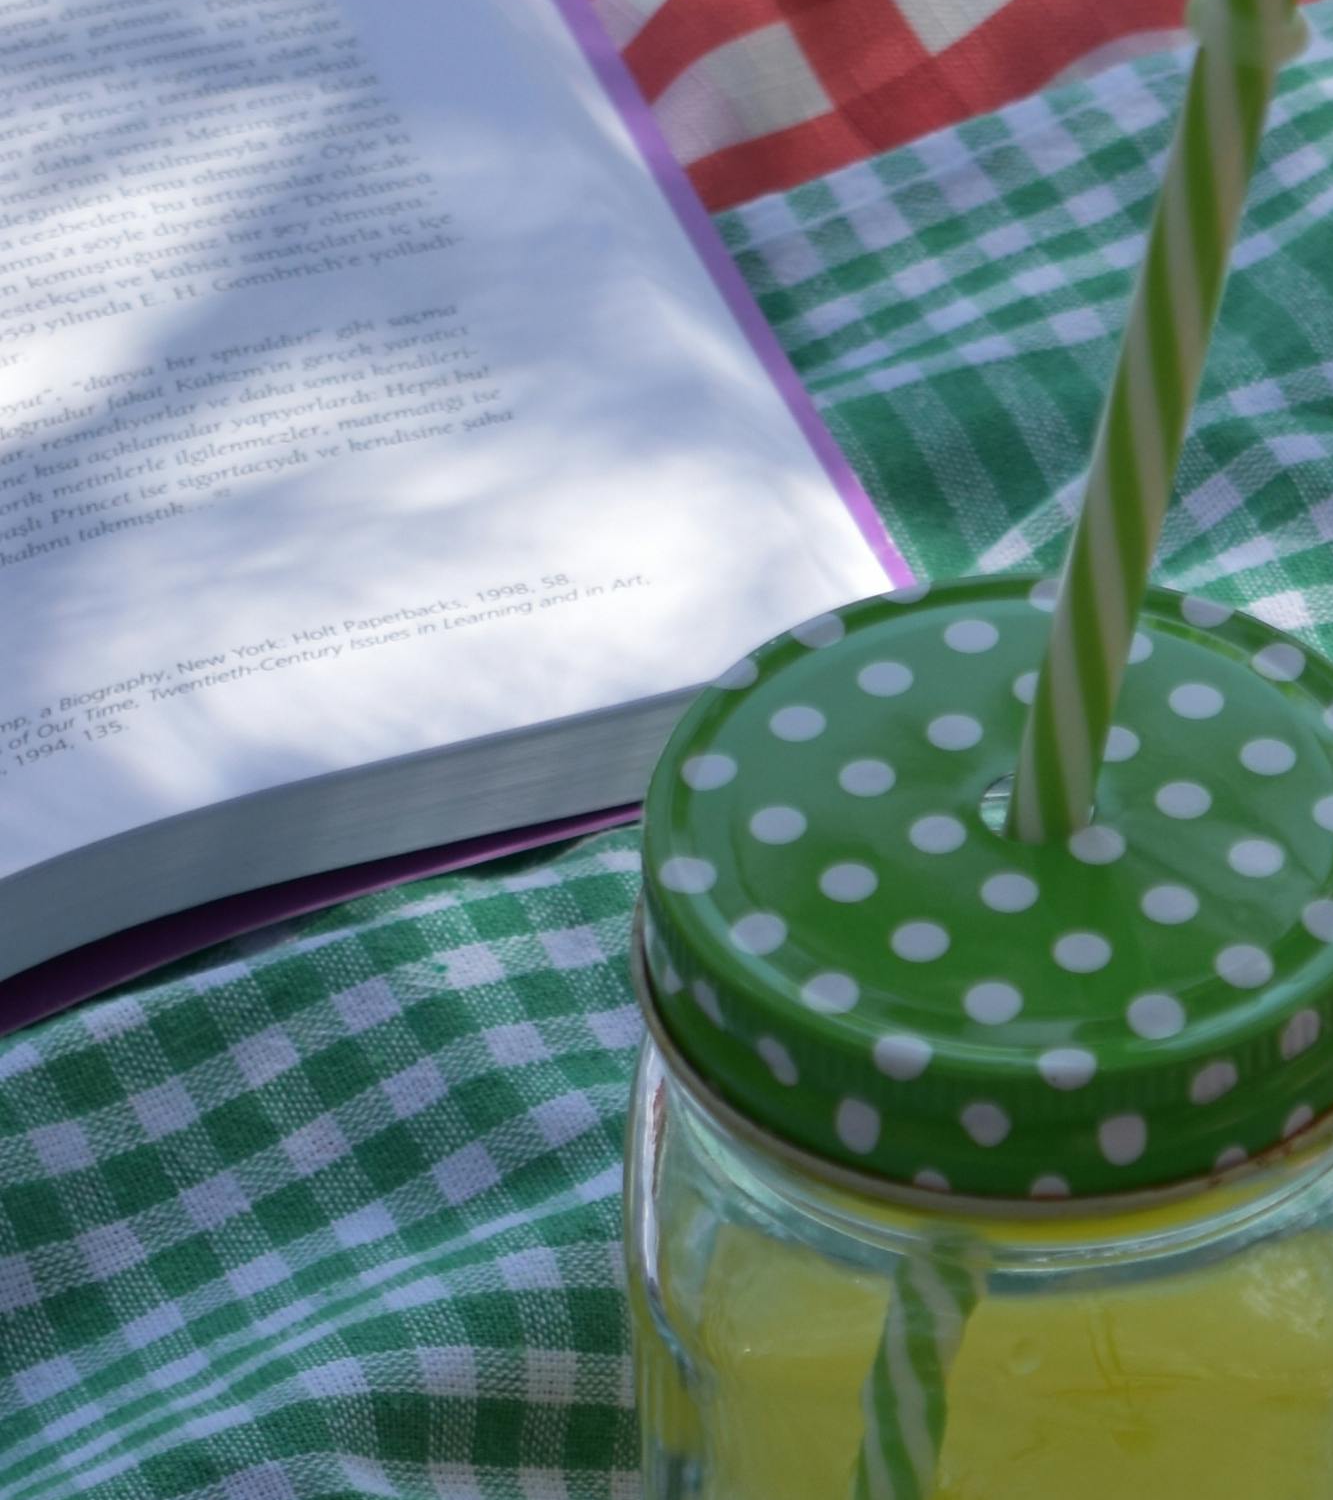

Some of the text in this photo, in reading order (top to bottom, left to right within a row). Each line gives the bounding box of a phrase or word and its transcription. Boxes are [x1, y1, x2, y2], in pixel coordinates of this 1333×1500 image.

[101, 78, 140, 91] bir
[30, 152, 95, 175] daha
[102, 136, 175, 159] sonra
[116, 178, 187, 196] konu
[149, 201, 187, 212] bu
[79, 230, 148, 253] şöyle
[224, 227, 263, 244] bir
[270, 220, 311, 238] şey
[0, 283, 109, 319] estekçisi
[111, 275, 144, 288] ve
[148, 256, 233, 281] kübist
[387, 223, 413, 235] iç
[417, 213, 456, 229] içe
[41, 301, 134, 333] yılında
[138, 294, 167, 307] E.
[170, 285, 205, 299] H.
[102, 385, 164, 418] fakat
[300, 342, 374, 369] gerçek
[163, 352, 198, 372] bir
[33, 456, 81, 478] kısa
[86, 423, 222, 462] açıklamalar
[383, 374, 450, 397] Hepsi
[39, 402, 199, 451] resmediyorlar
[205, 396, 231, 408] ve
[237, 383, 296, 402] daha
[301, 370, 366, 388] sonra
[49, 492, 132, 524] Princet
[137, 483, 169, 498] ise
[175, 449, 308, 487] sigortacıydı
[313, 444, 340, 458] ve
[345, 423, 454, 452] kendisine
[51, 460, 167, 497] metinlerle
[336, 397, 465, 429] matematiği
[471, 389, 503, 402] ise
[8, 729, 29, 749] of
[36, 717, 74, 738] Our
[149, 645, 341, 699] Twentieth-Century
[349, 629, 412, 648] Issues
[415, 622, 436, 635] in
[441, 601, 532, 629] Learning
[539, 587, 578, 608] and
[585, 584, 605, 596] in
[39, 706, 52, 719] a
[176, 654, 226, 674] New
[290, 624, 336, 643] Holt
